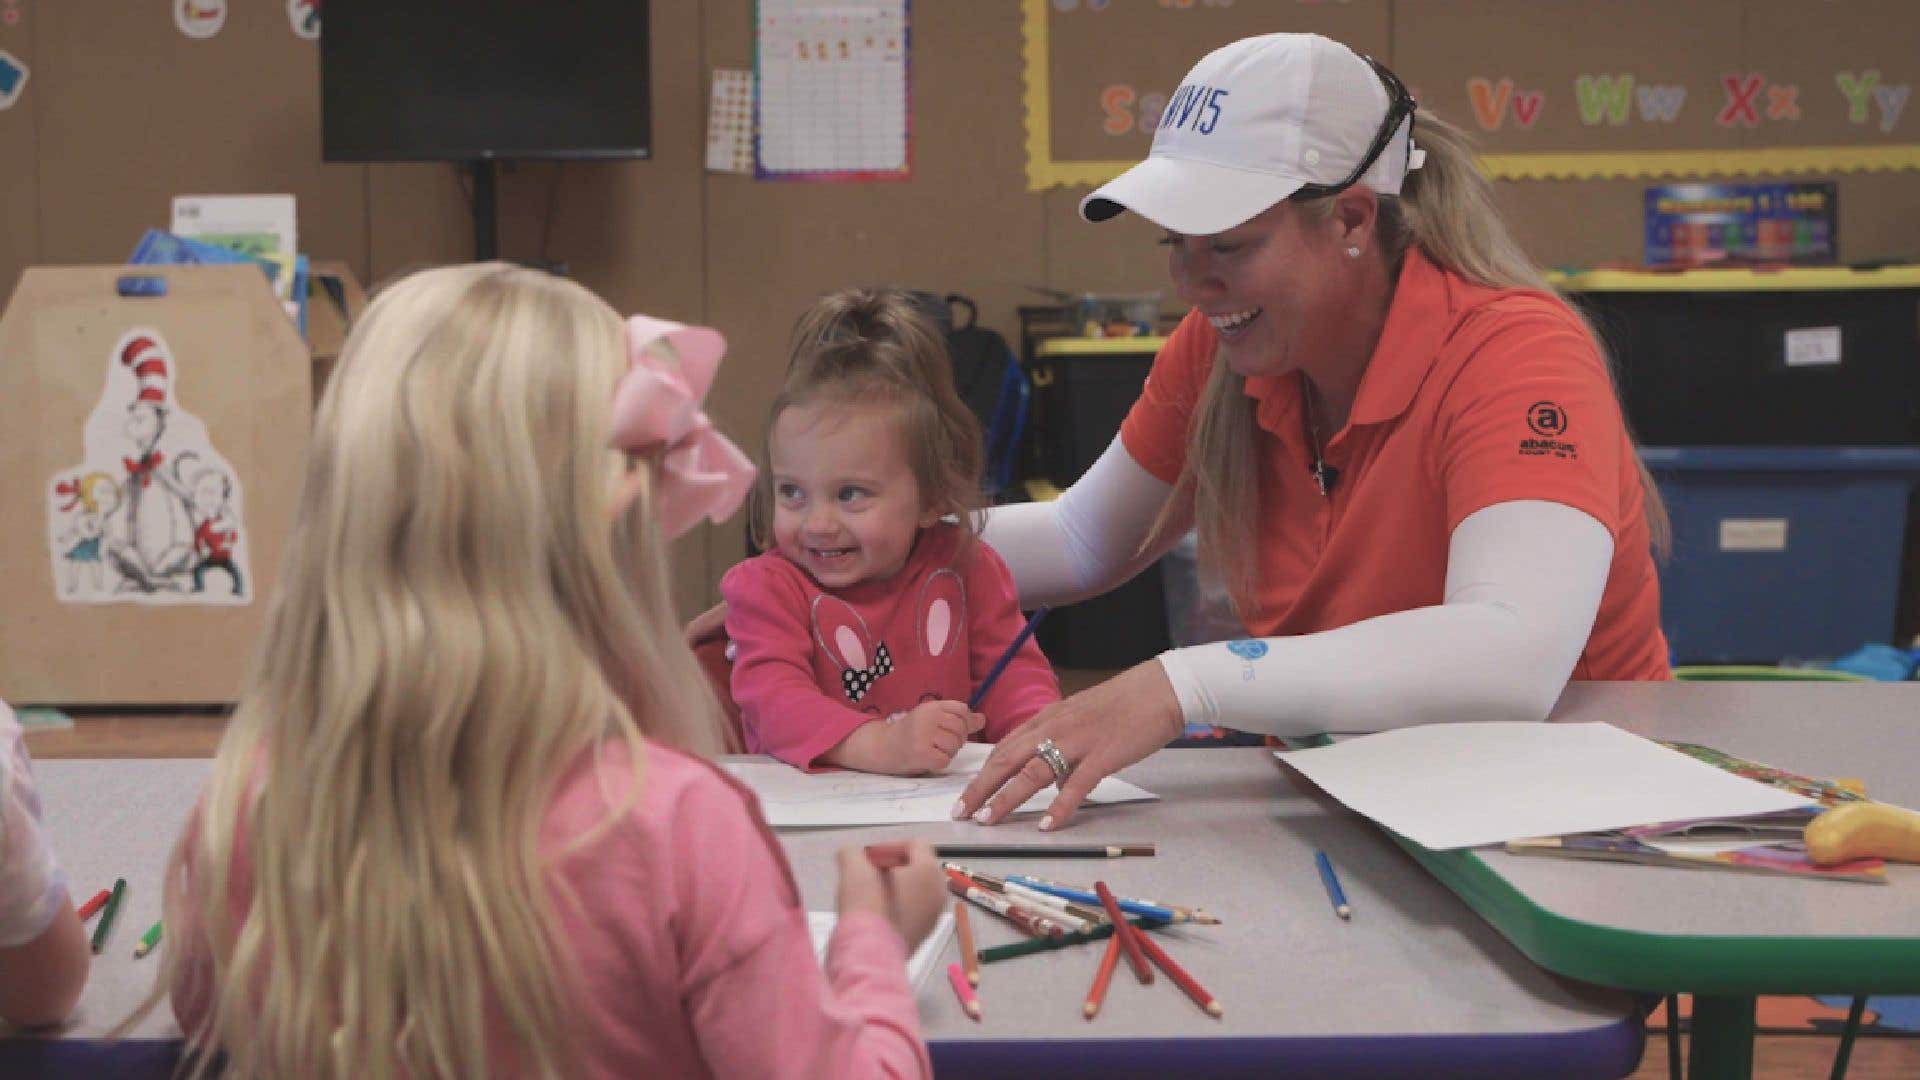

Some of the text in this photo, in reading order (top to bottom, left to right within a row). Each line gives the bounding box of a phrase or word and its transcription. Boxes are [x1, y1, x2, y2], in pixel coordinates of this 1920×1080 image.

[1469, 79, 1543, 128] Vv
[1577, 75, 1686, 124] Ww
[1718, 74, 1799, 126] Xx
[1836, 71, 1908, 132] Yy
